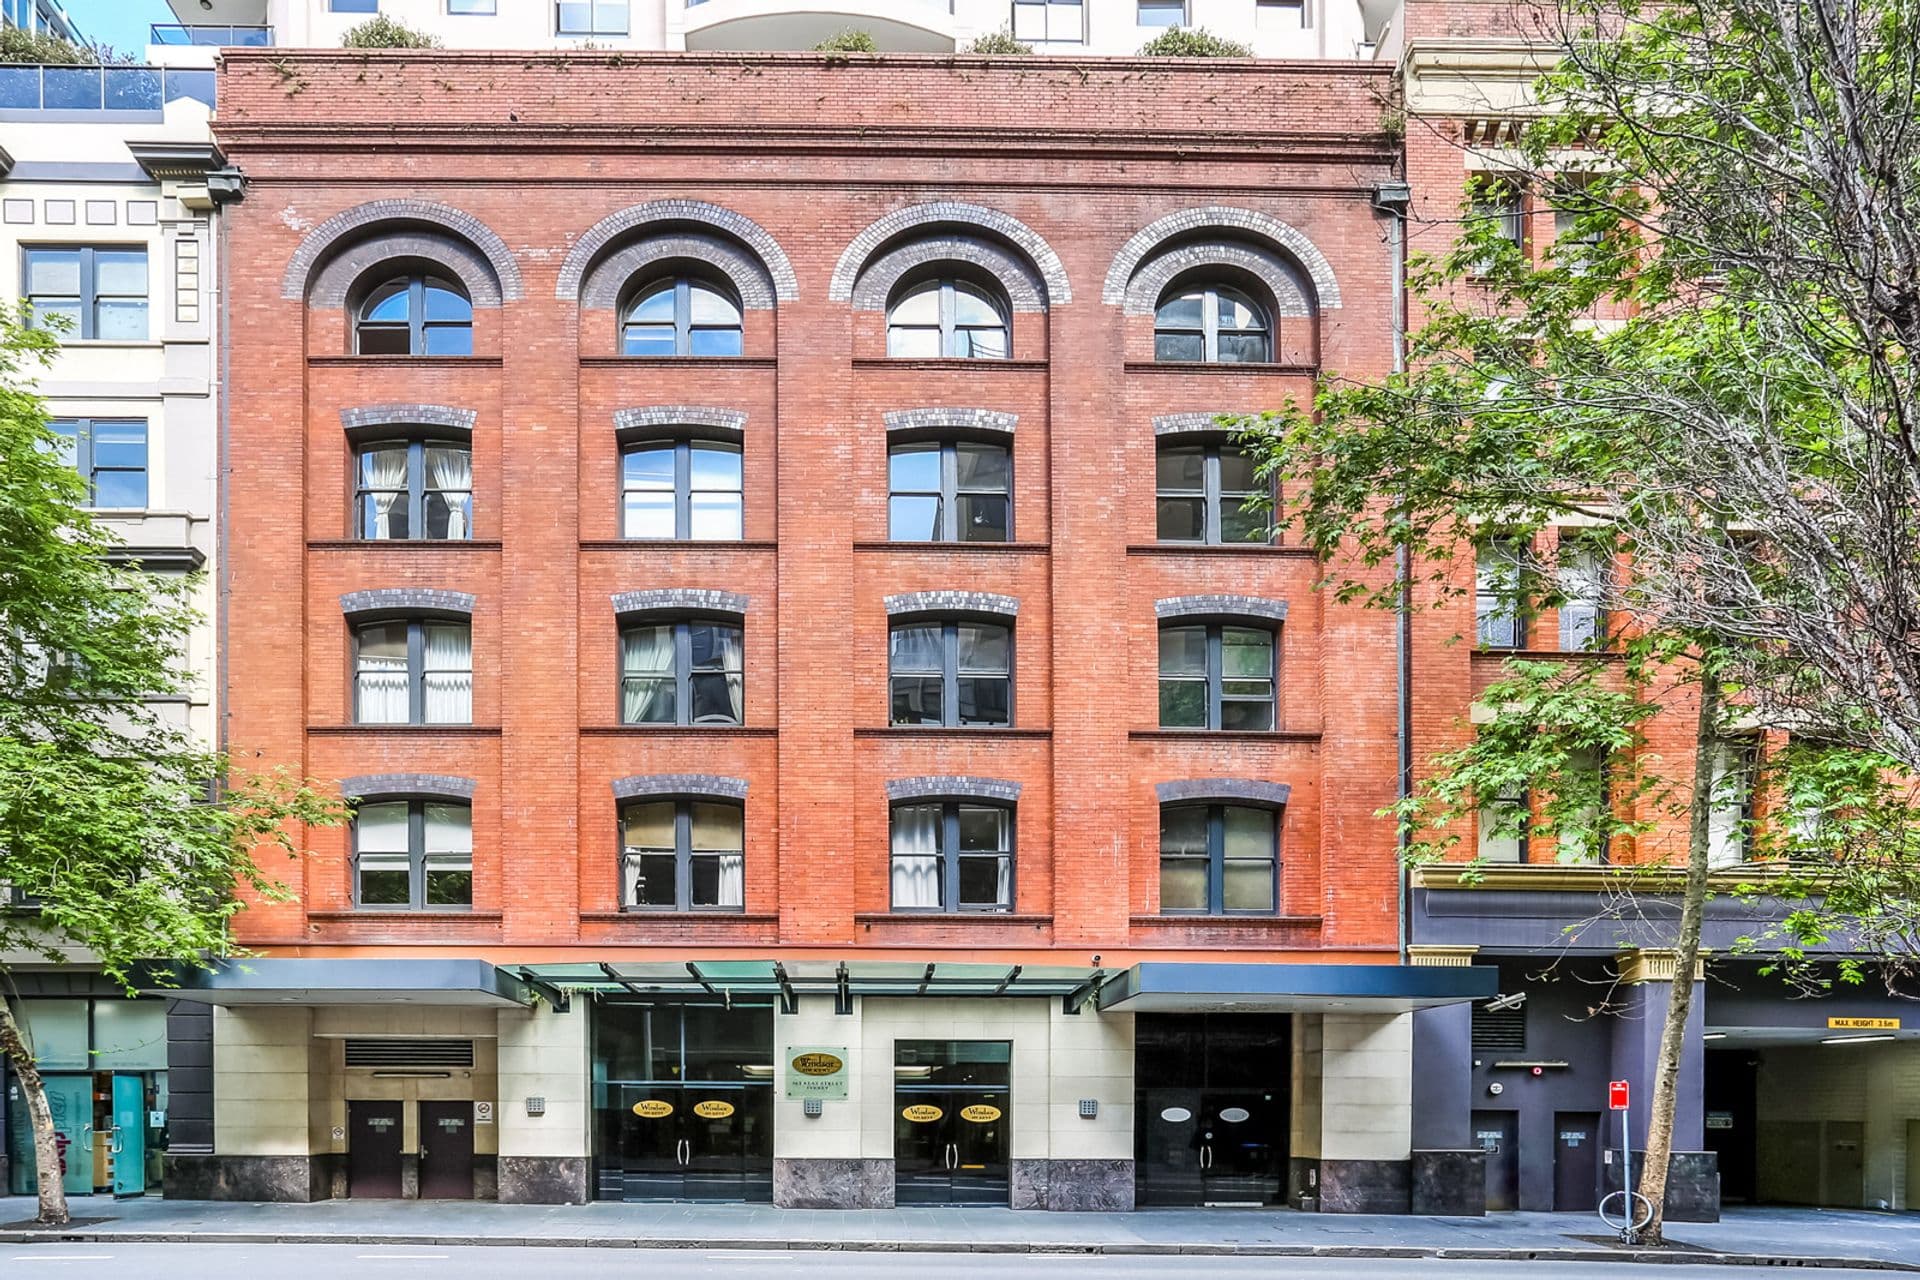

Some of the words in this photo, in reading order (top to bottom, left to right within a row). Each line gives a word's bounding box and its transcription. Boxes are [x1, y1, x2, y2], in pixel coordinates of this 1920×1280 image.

[1852, 1019, 1873, 1027] HEIGHT
[800, 1056, 834, 1067] Windsor
[640, 1103, 666, 1111] Windsor
[702, 1103, 728, 1111] Windsor
[968, 1107, 994, 1115] Windsor
